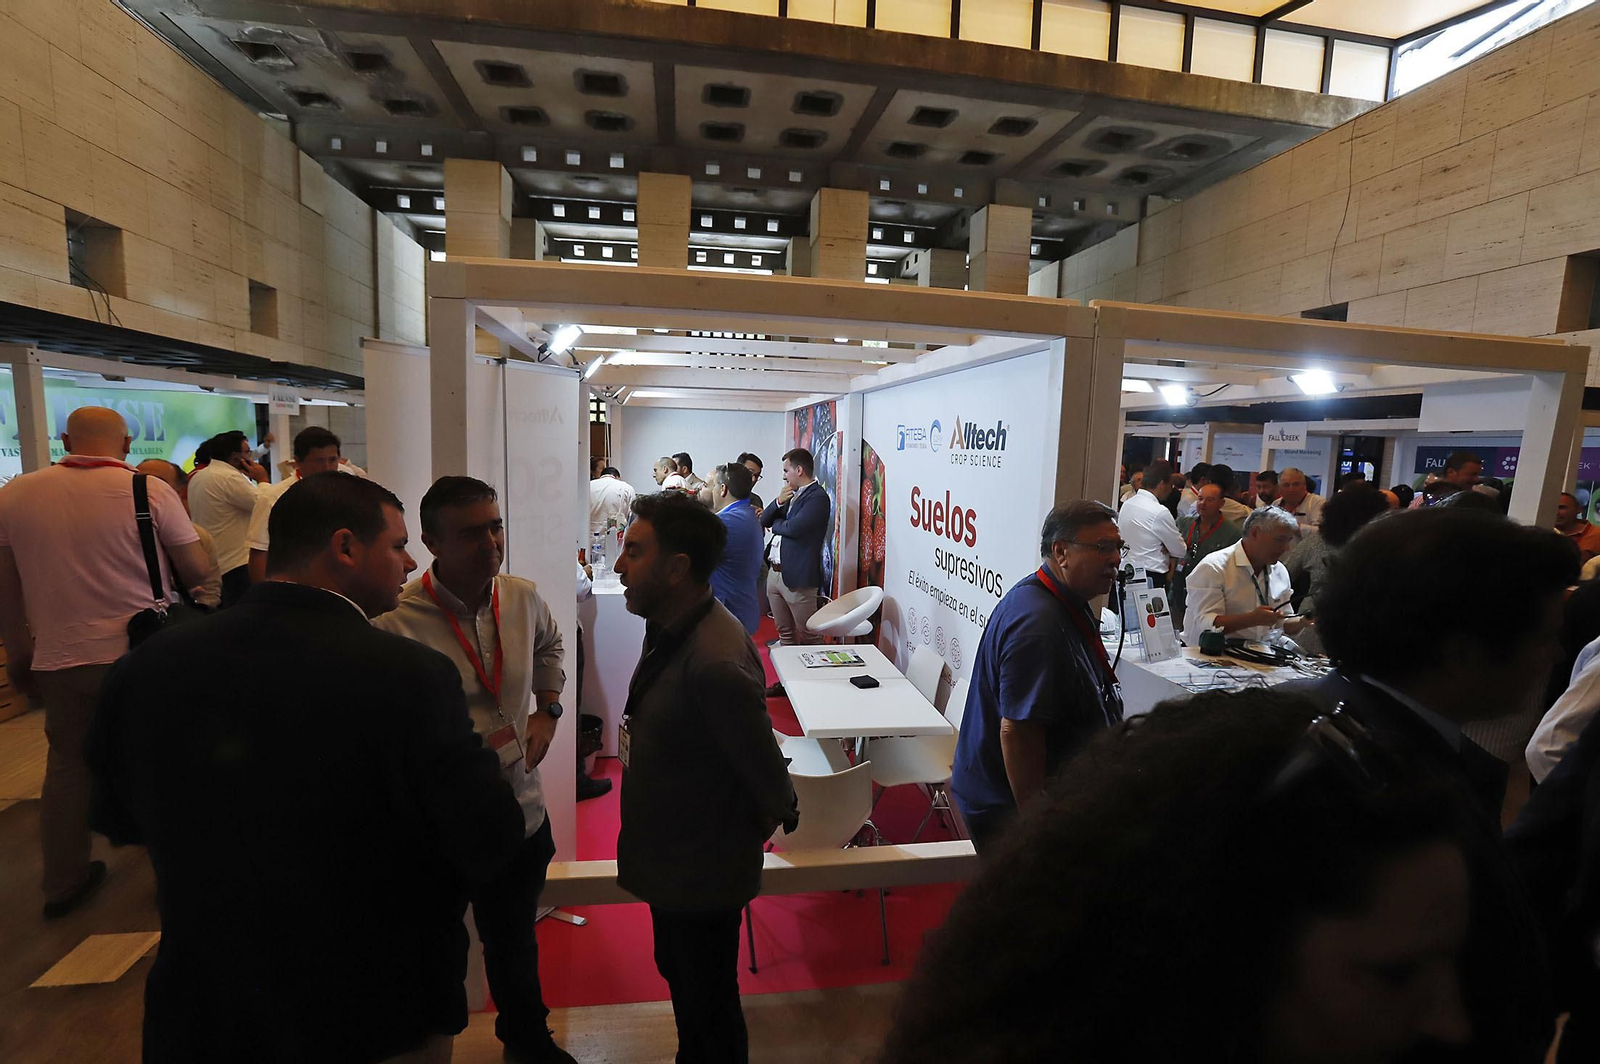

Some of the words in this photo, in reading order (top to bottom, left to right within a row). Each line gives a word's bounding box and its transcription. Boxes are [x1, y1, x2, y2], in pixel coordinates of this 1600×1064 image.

[949, 415, 1007, 451] Alltech
[1281, 433, 1299, 441] CREEK
[950, 453, 968, 465] CROP
[970, 454, 1001, 469] SCIENCE
[909, 486, 977, 548] Suelos
[934, 547, 1003, 598] supresivos
[908, 569, 915, 585] El
[915, 573, 929, 594] éxito
[930, 587, 958, 612] empieza
[959, 602, 968, 619] en
[970, 606, 979, 624] el
